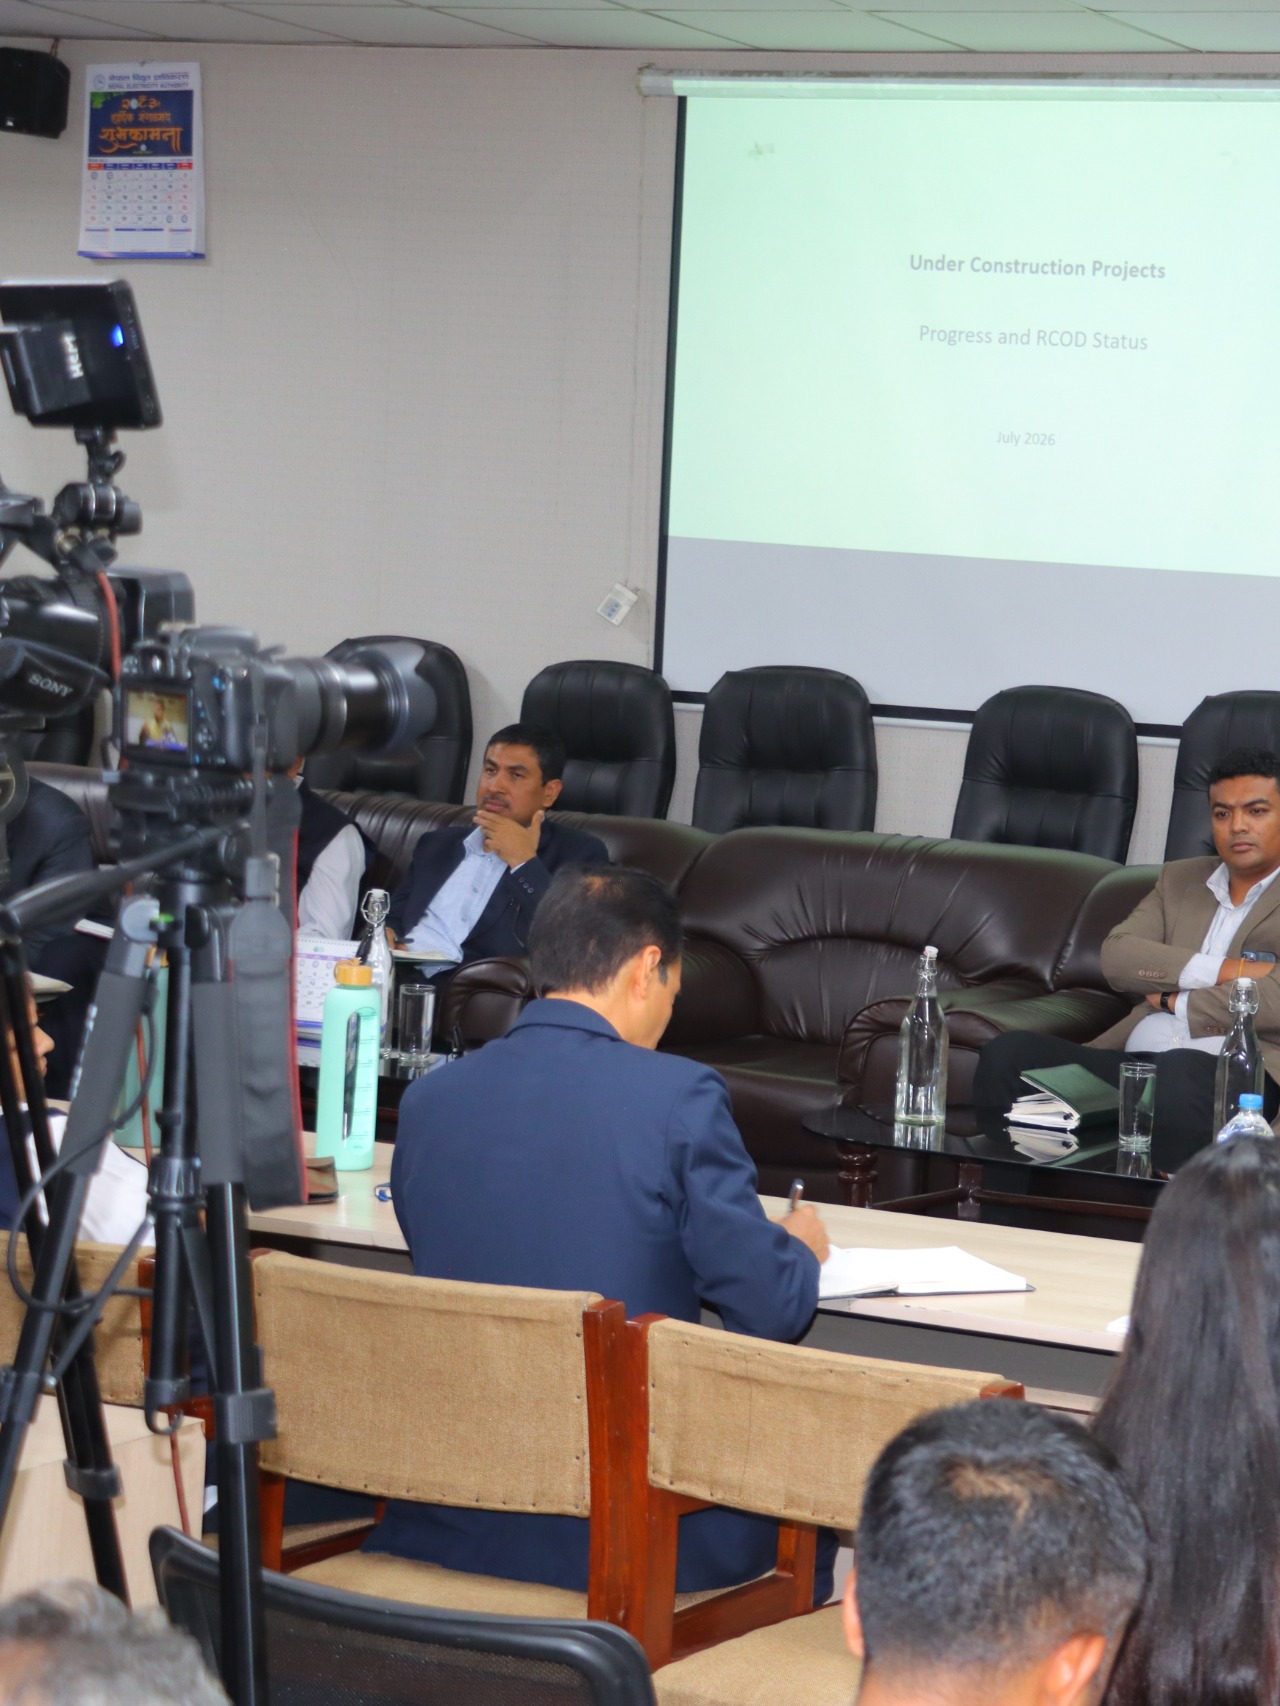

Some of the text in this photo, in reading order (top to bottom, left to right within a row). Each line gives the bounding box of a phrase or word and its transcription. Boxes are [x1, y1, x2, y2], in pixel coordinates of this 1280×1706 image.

[909, 254, 1166, 281] Under Construction Projects
[919, 325, 1148, 351] Progress and RCOD Status
[997, 431, 1056, 447] July 2026
[29, 673, 74, 697] SONY
